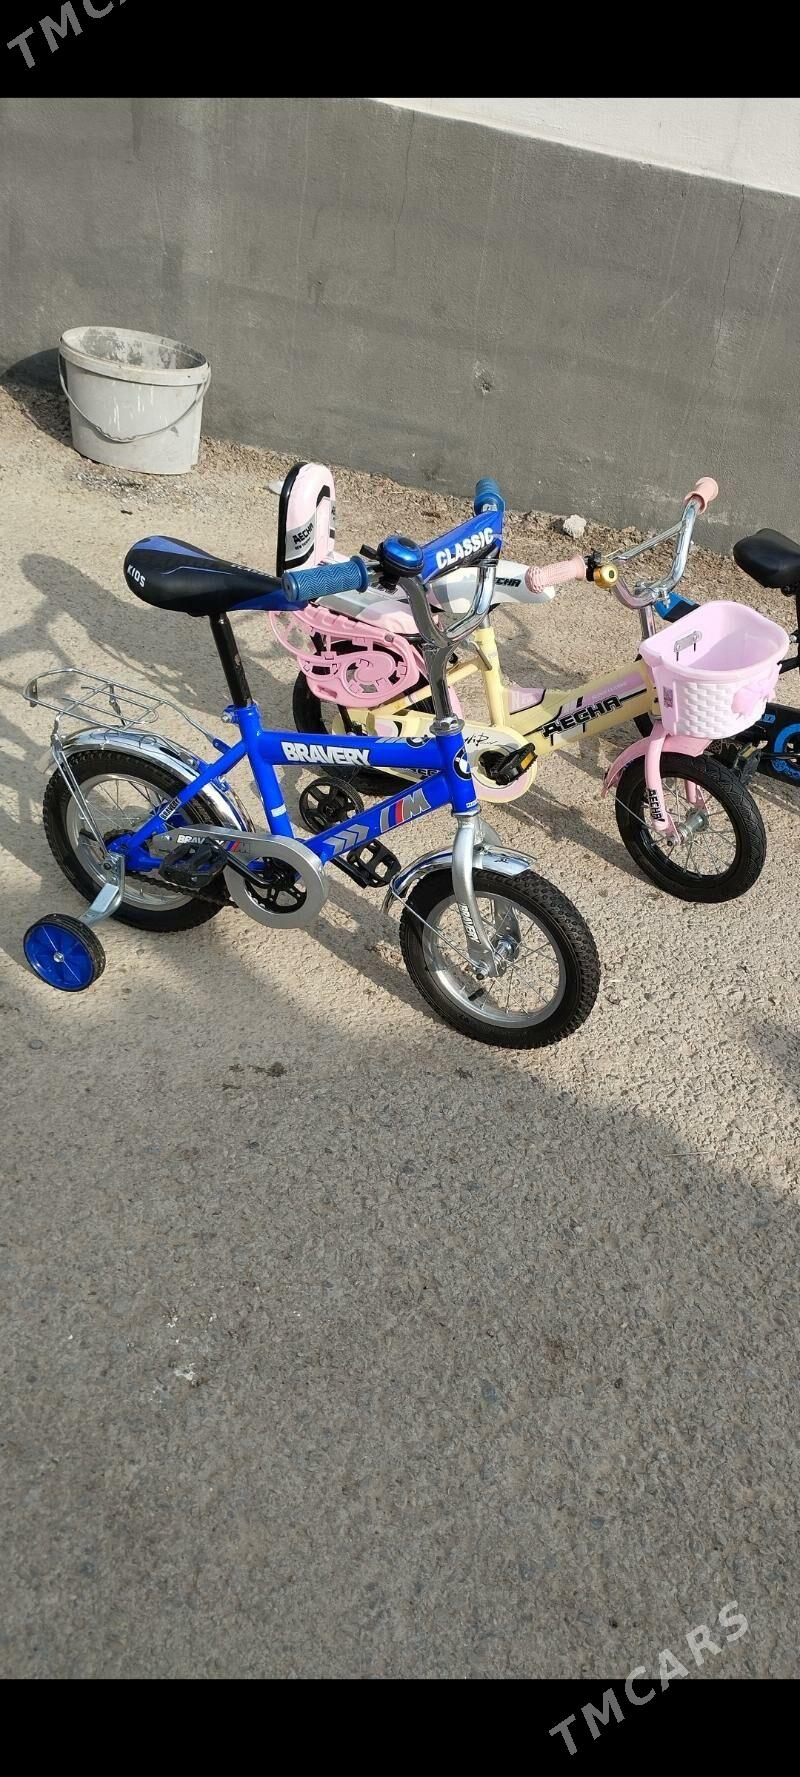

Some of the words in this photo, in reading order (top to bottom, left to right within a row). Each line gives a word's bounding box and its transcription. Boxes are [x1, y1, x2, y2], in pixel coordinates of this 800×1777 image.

[435, 527, 494, 570] CLASSIC
[127, 564, 146, 588] KIDS
[281, 741, 371, 767] BRAVERY
[176, 834, 224, 850] BRAVY
